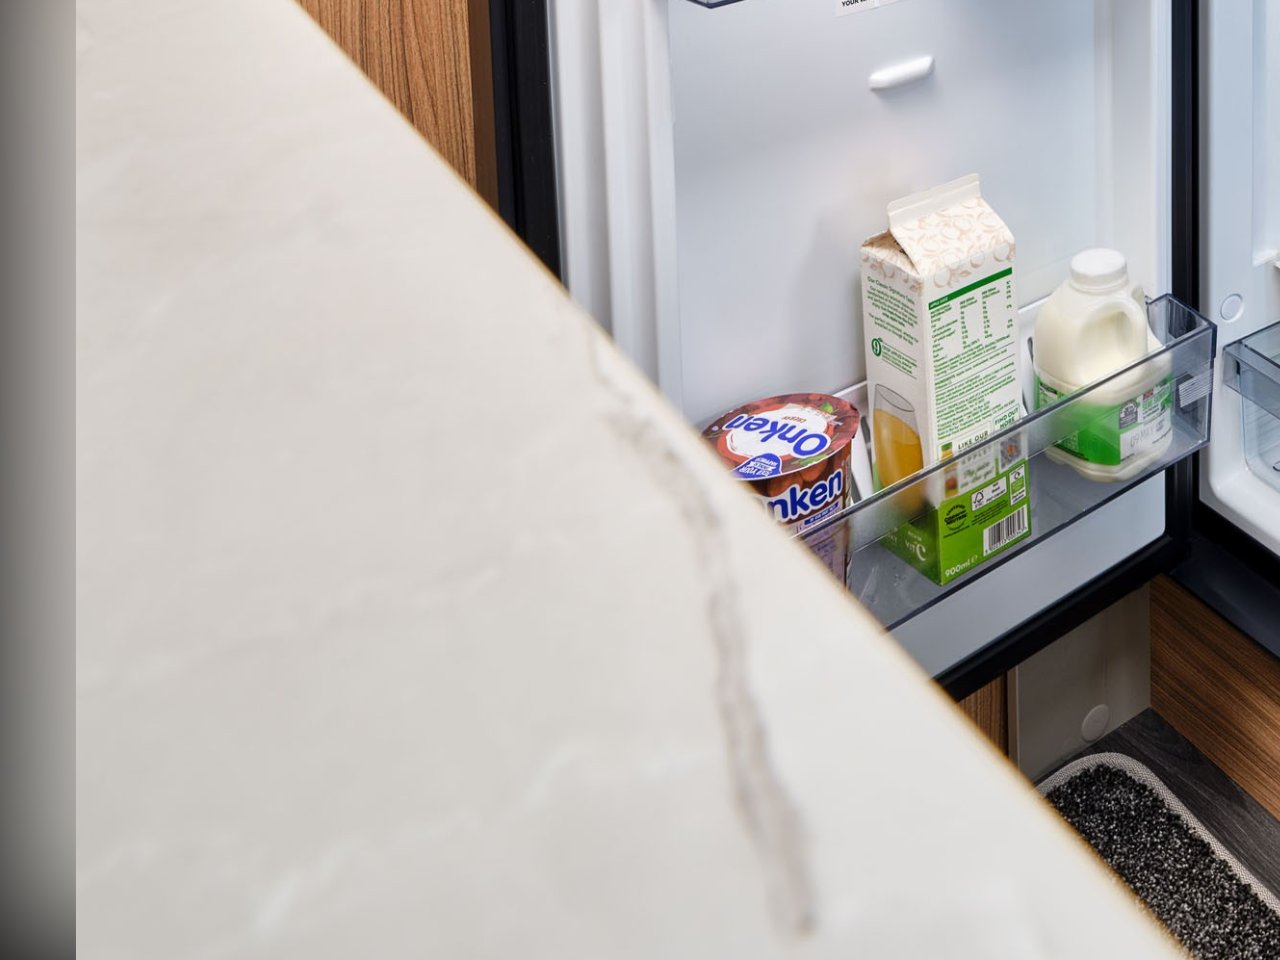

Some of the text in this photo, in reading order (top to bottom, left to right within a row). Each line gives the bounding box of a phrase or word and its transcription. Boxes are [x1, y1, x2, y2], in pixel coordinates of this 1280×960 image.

[994, 407, 1019, 425] FIND OUT
[1000, 417, 1015, 429] MORE
[725, 415, 828, 456] Onken
[958, 431, 989, 450] LIKE OUR
[768, 471, 842, 518] nken
[945, 558, 970, 577] 900ml
